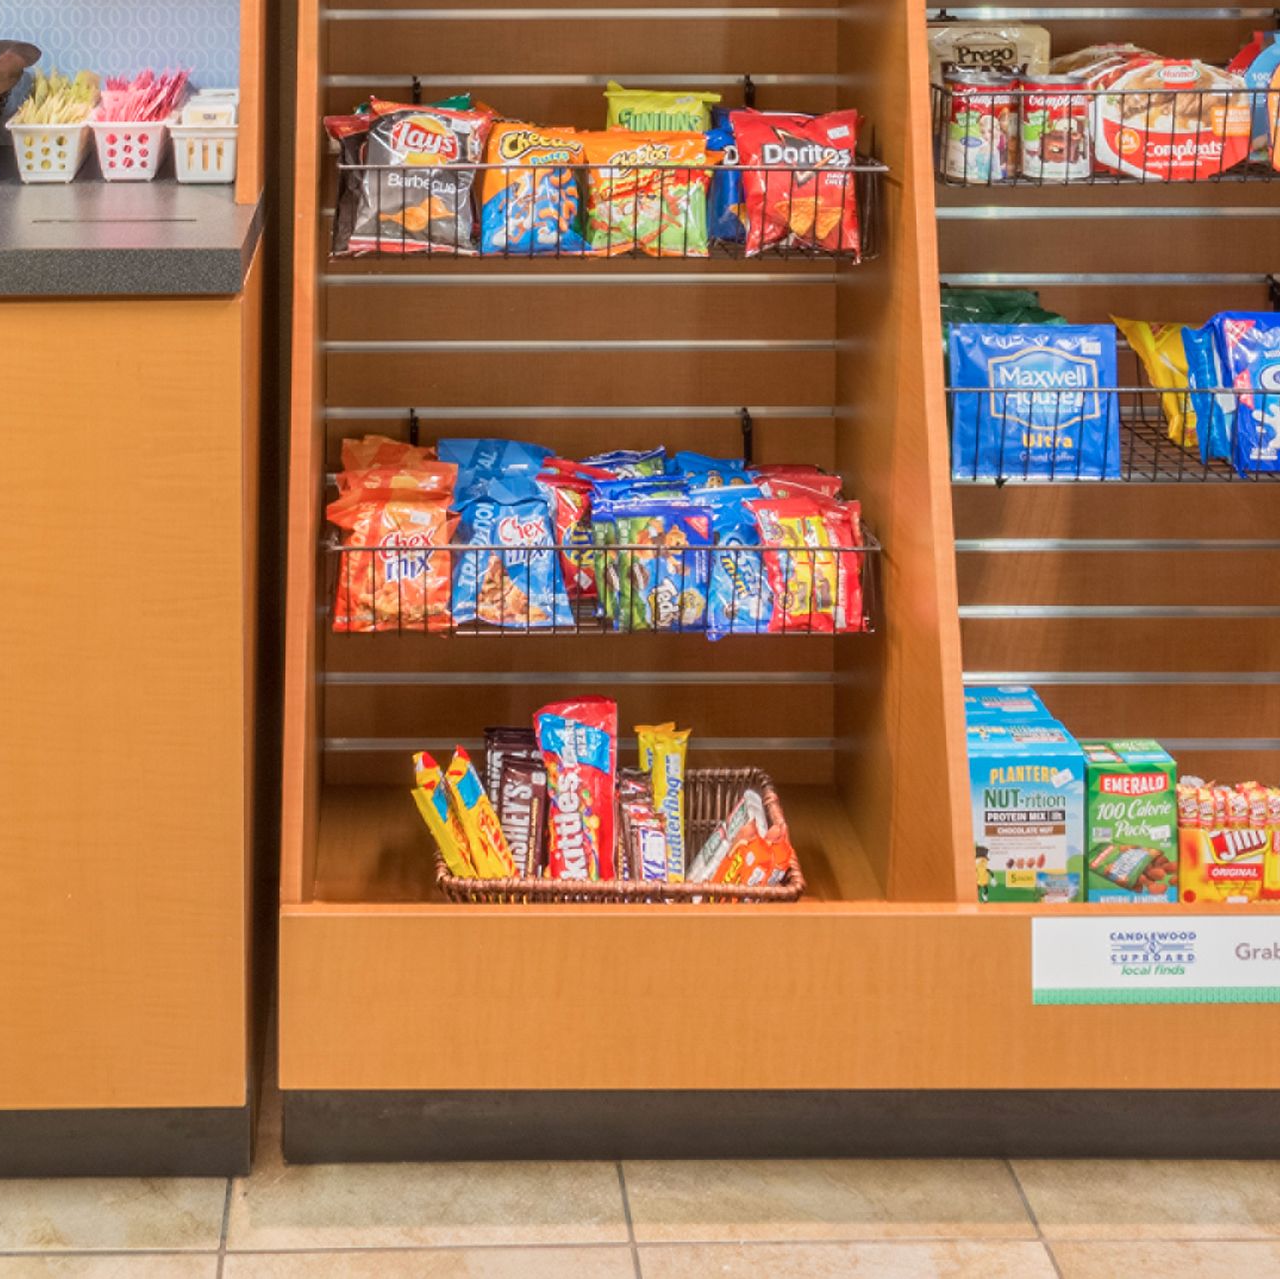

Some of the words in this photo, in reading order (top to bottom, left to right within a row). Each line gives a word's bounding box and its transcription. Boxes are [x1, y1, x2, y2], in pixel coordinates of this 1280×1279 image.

[957, 45, 1014, 68] Prego
[763, 144, 852, 167] Doritos
[1145, 140, 1225, 160] Compleats
[387, 172, 457, 194] Barbecue
[999, 365, 1087, 388] Maxwell
[1023, 433, 1073, 448] Ultra
[499, 516, 545, 542] Chex
[379, 528, 436, 558] Chex
[990, 765, 1058, 784] PLANTERS
[1103, 775, 1166, 794] EMERALD
[662, 755, 683, 875] Butterfing
[987, 812, 1027, 822] PROTEIN
[1029, 811, 1046, 821] MIX
[1097, 802, 1124, 821] 100
[1126, 799, 1172, 820] Calorie
[553, 771, 588, 880] kittles
[997, 826, 1038, 835] CHOCOLATE
[1039, 826, 1054, 834] NUT
[1115, 820, 1152, 839] Packs
[1211, 867, 1259, 878] ORIGINAL
[1109, 931, 1197, 941] CANDLEWOOD
[1110, 953, 1197, 963] CUPBOARD
[1121, 964, 1150, 976] local
[1153, 964, 1186, 976] finds
